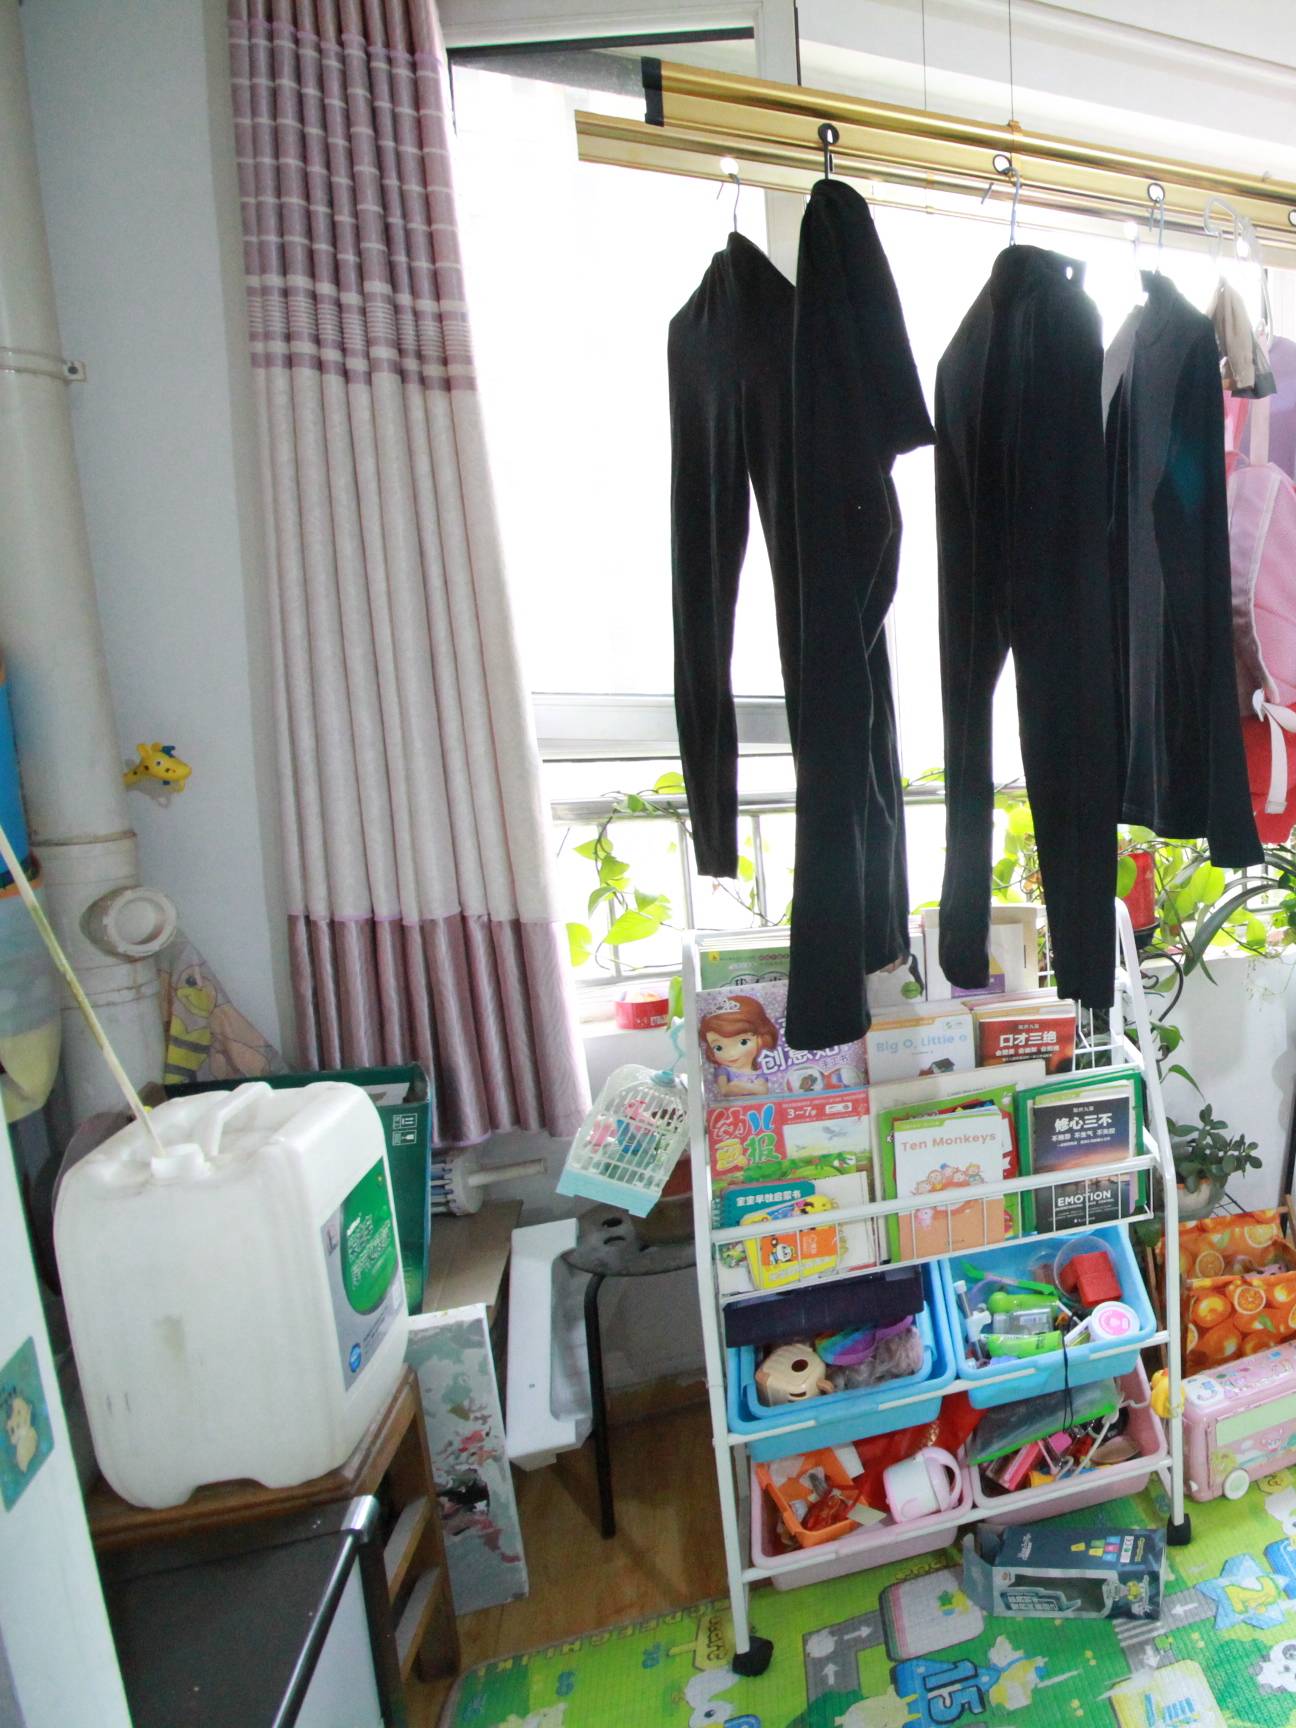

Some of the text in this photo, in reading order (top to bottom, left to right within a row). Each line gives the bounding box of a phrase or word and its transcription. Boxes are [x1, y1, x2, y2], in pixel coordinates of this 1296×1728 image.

[876, 1040, 899, 1054] Big
[921, 1034, 955, 1047] Little
[758, 1043, 849, 1074] 创意
[1054, 1112, 1113, 1133] 修心三不
[901, 1132, 997, 1152] Ten Monkeys
[922, 1658, 987, 1725] 15
